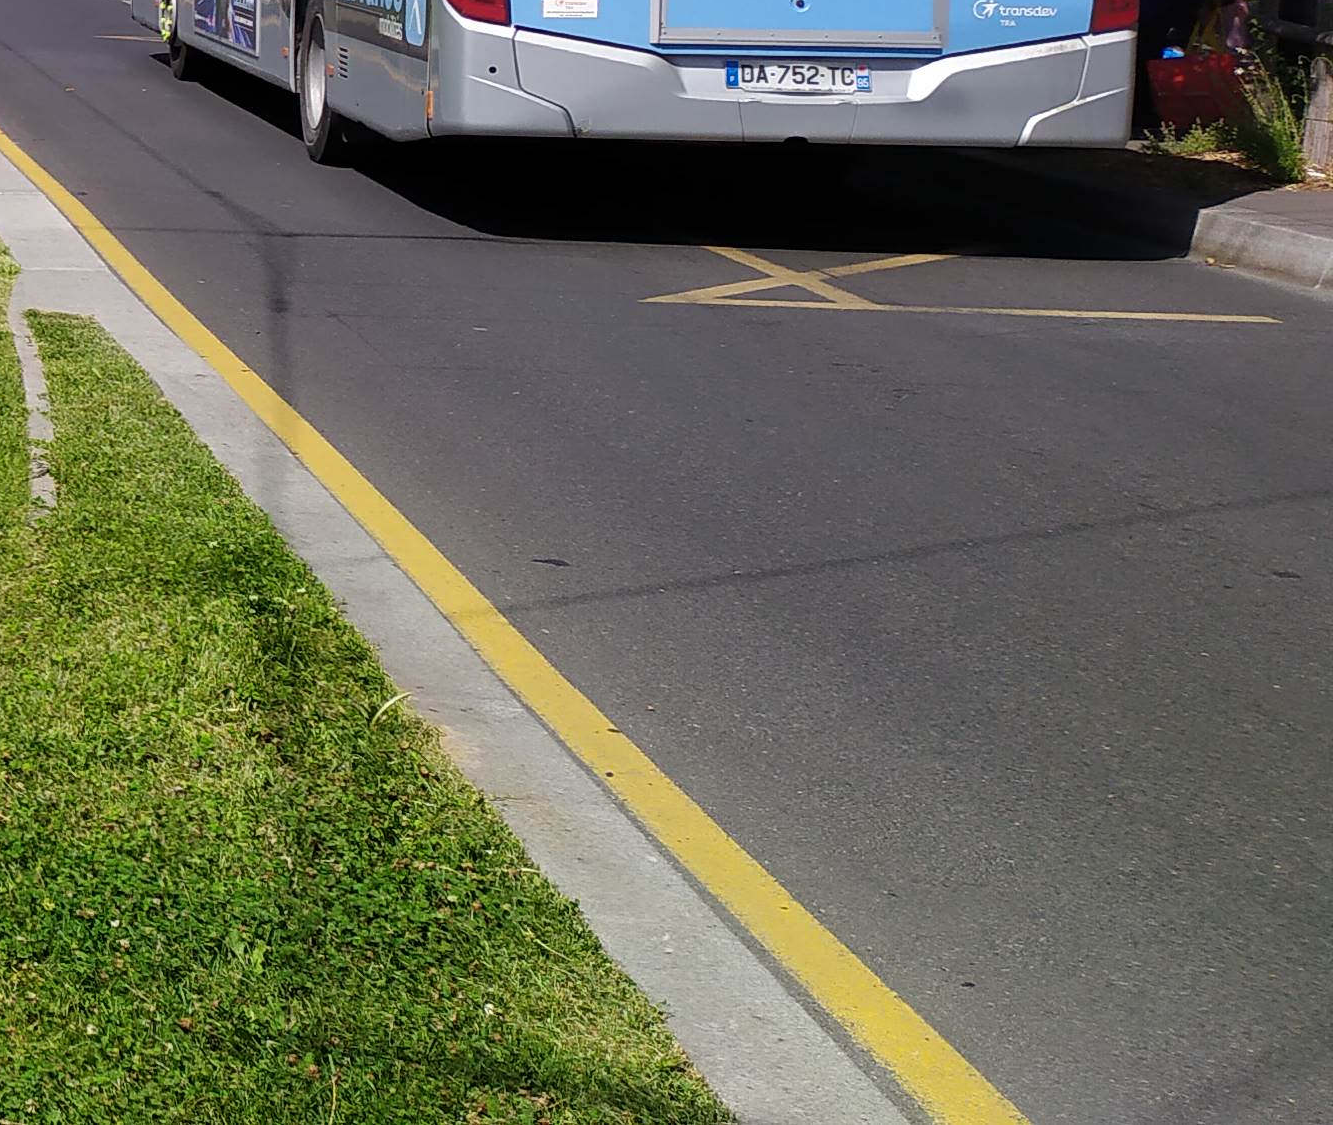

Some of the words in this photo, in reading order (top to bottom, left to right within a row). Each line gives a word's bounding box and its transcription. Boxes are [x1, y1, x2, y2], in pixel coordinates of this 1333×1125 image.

[999, 5, 1058, 17] transdev
[741, 63, 855, 87] DA-752-TC
[857, 77, 870, 87] 95
